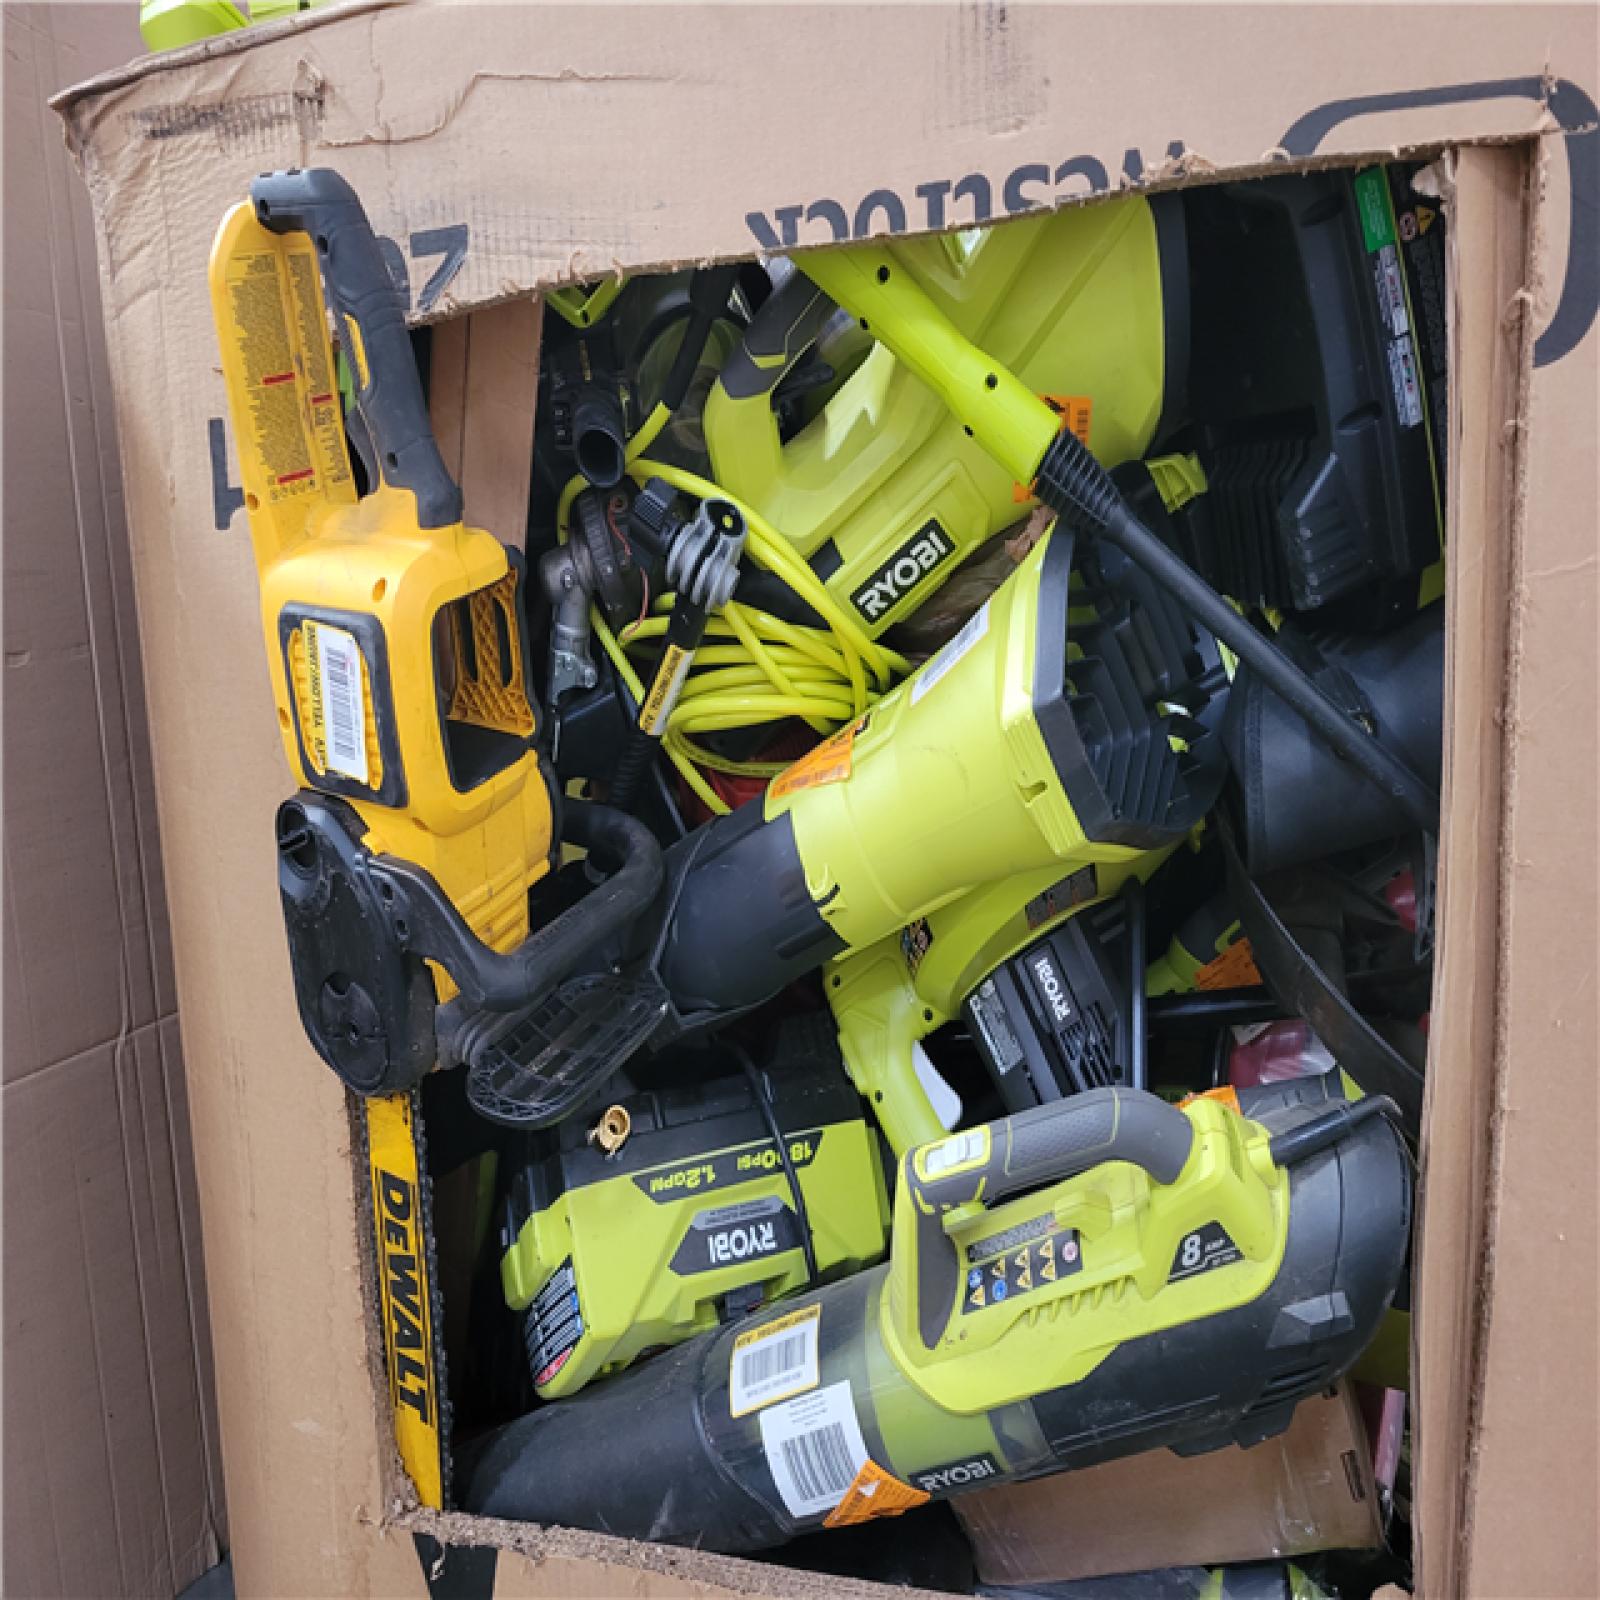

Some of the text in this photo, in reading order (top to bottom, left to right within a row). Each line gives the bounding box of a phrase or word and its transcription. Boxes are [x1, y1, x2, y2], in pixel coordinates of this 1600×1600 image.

[857, 530, 948, 617] RYOBI
[1034, 957, 1071, 1021] RYOBI
[707, 1221, 778, 1264] RYOBI
[1182, 1234, 1202, 1266] 8
[380, 1170, 430, 1425] DEWALT
[918, 1459, 996, 1492] RYOBI
